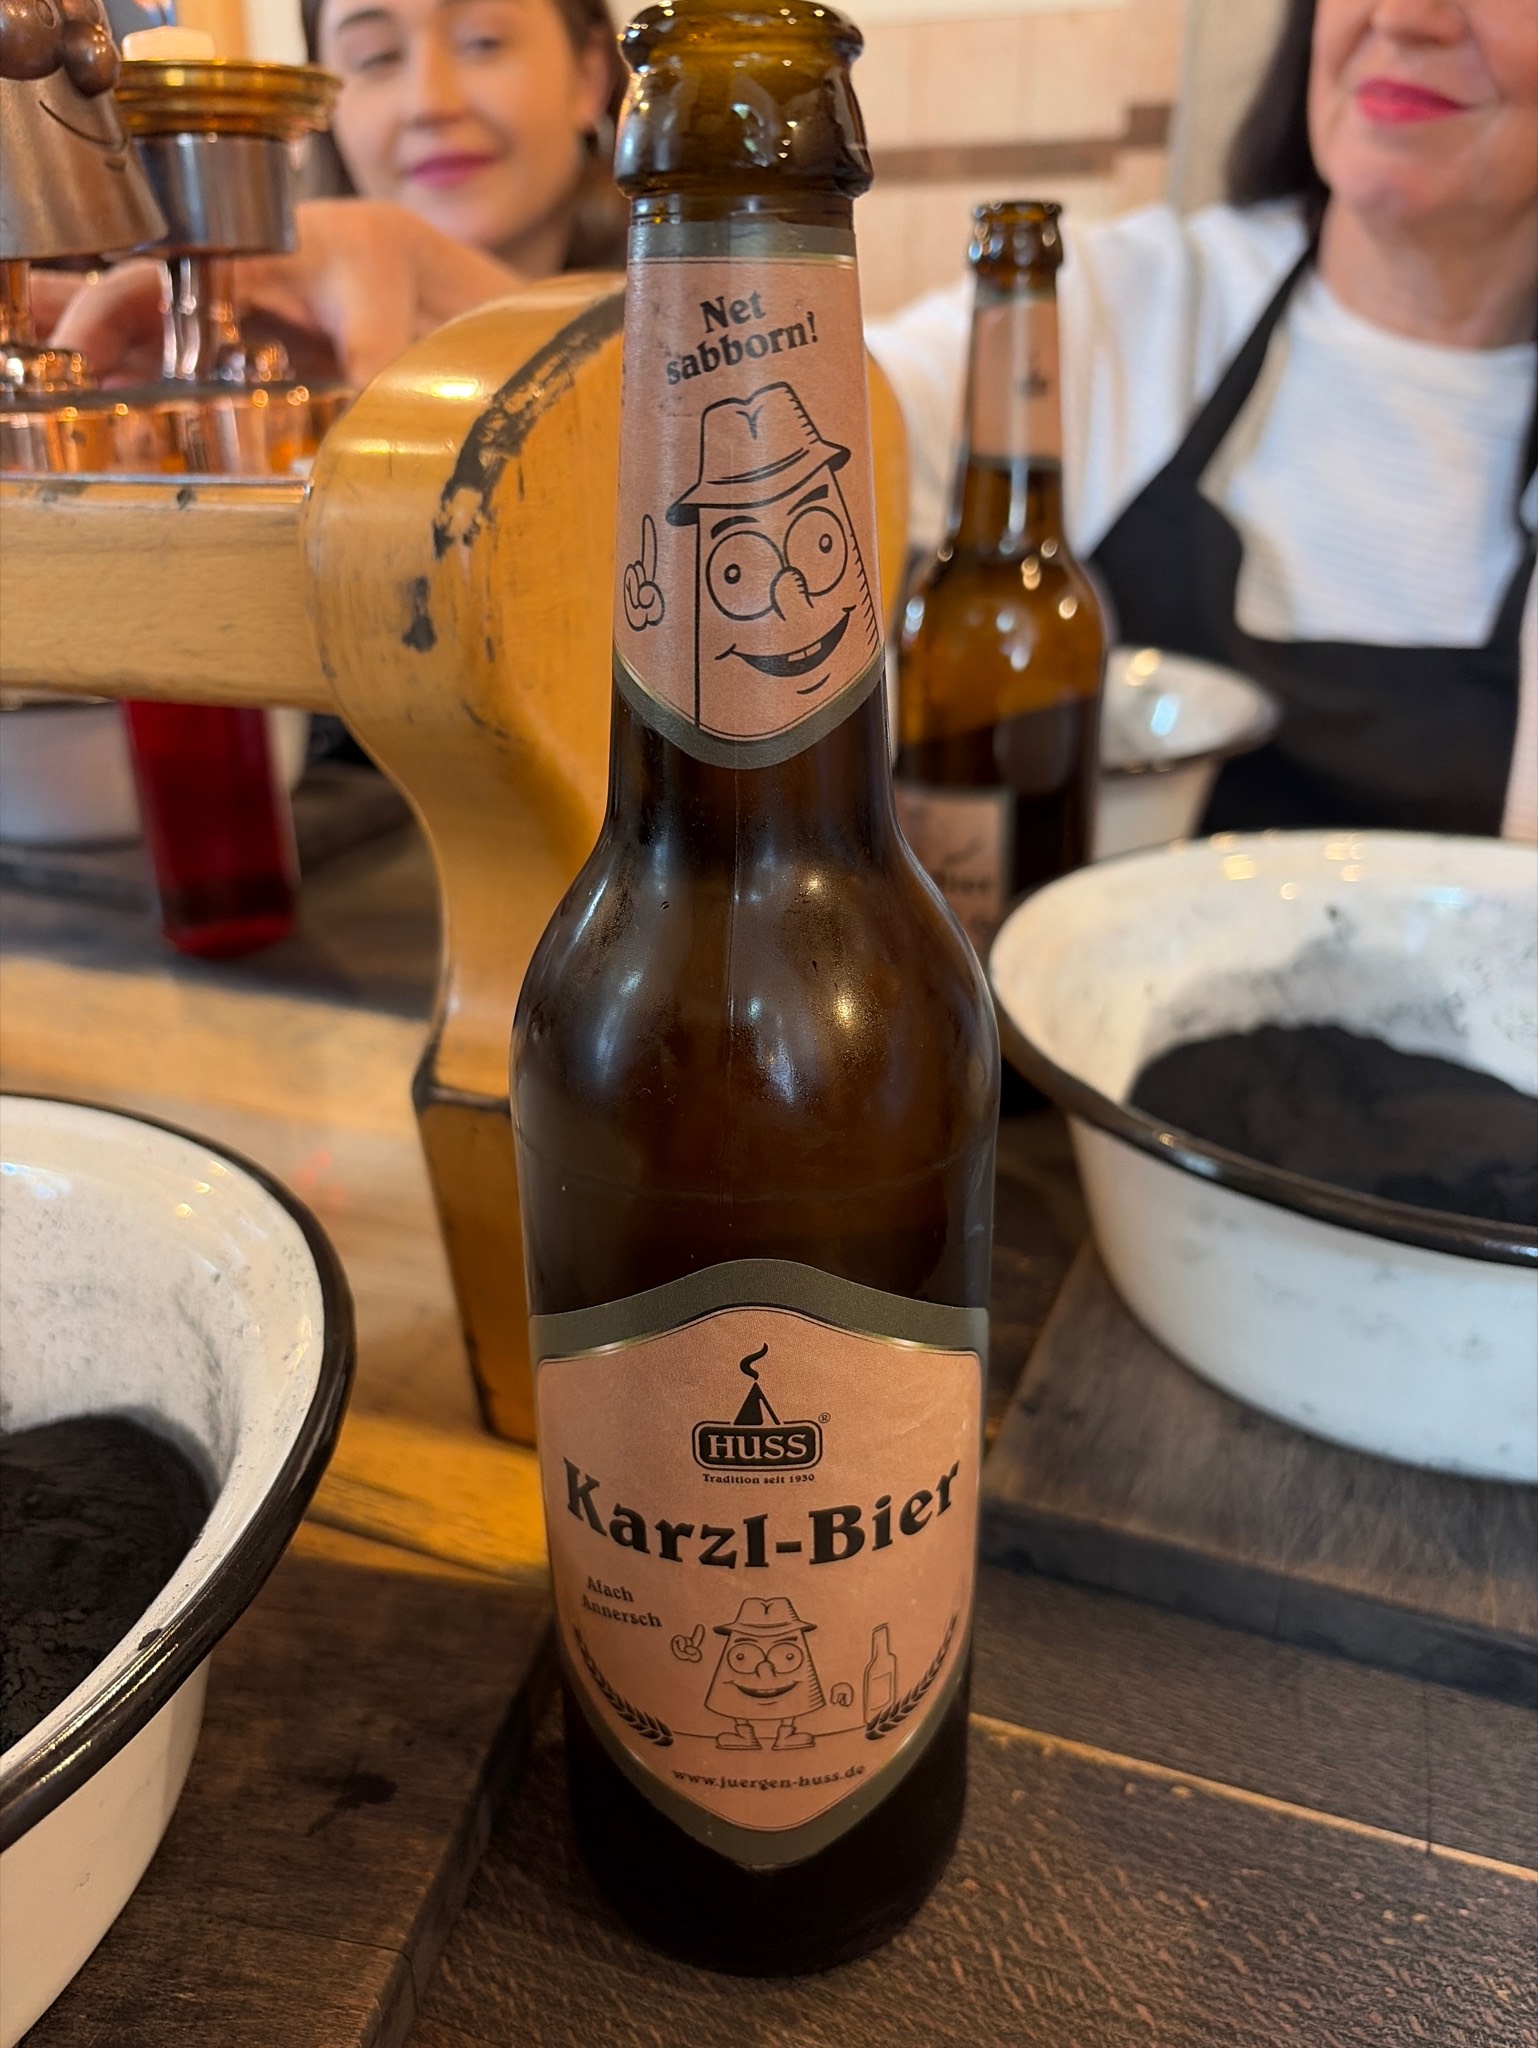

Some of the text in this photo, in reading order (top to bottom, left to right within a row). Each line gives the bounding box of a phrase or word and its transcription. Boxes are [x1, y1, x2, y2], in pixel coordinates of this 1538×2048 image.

[700, 290, 766, 334] Net
[666, 311, 818, 385] sabborn!
[708, 1433, 807, 1459] HUSS
[702, 1473, 815, 1484] Tradition seit 1930
[563, 1457, 961, 1569] Karzl-Bier
[582, 1593, 662, 1628] Annersch
[672, 1765, 865, 1791] www.juergen-huss.de
